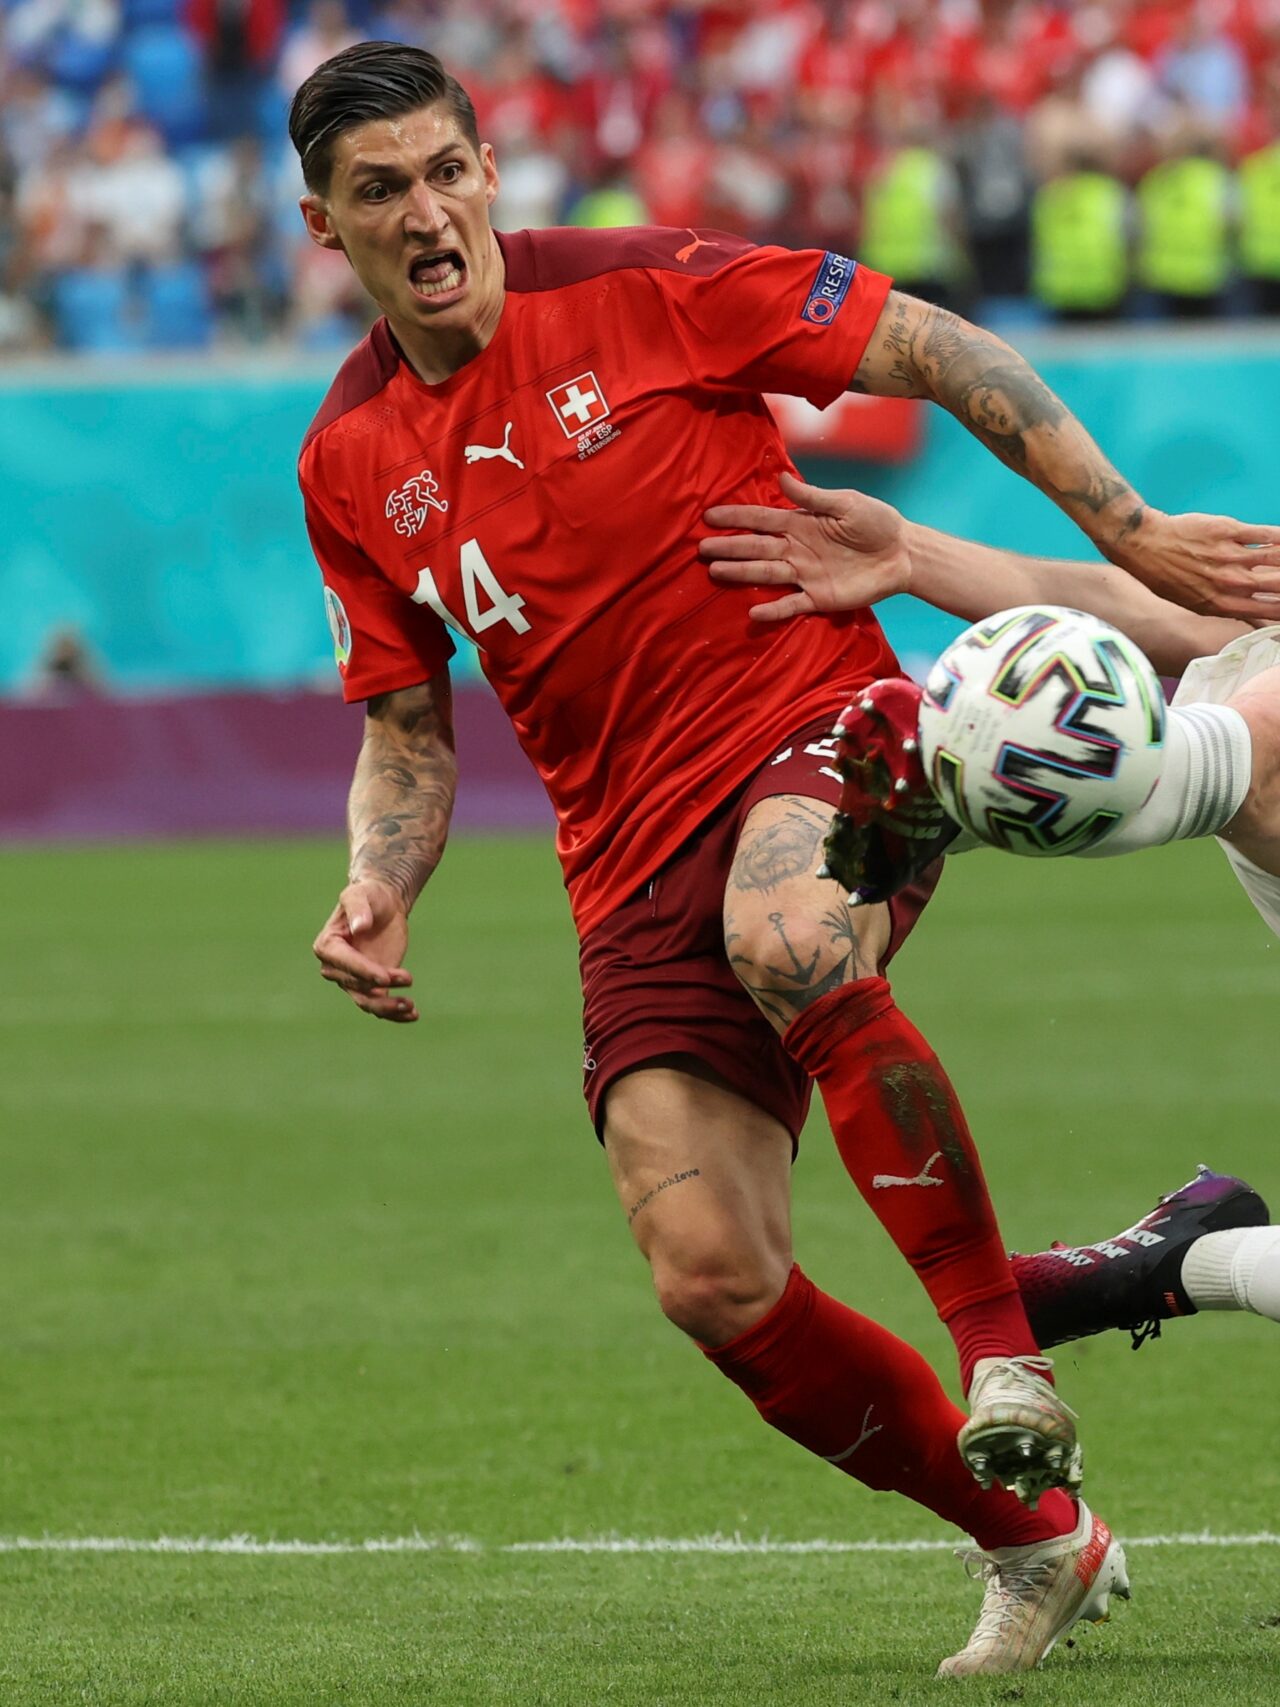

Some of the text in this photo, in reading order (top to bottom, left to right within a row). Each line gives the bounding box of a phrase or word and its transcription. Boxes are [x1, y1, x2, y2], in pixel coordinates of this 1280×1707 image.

[577, 437, 592, 452] SUI
[596, 424, 613, 440] ESP
[410, 538, 533, 653] 14
